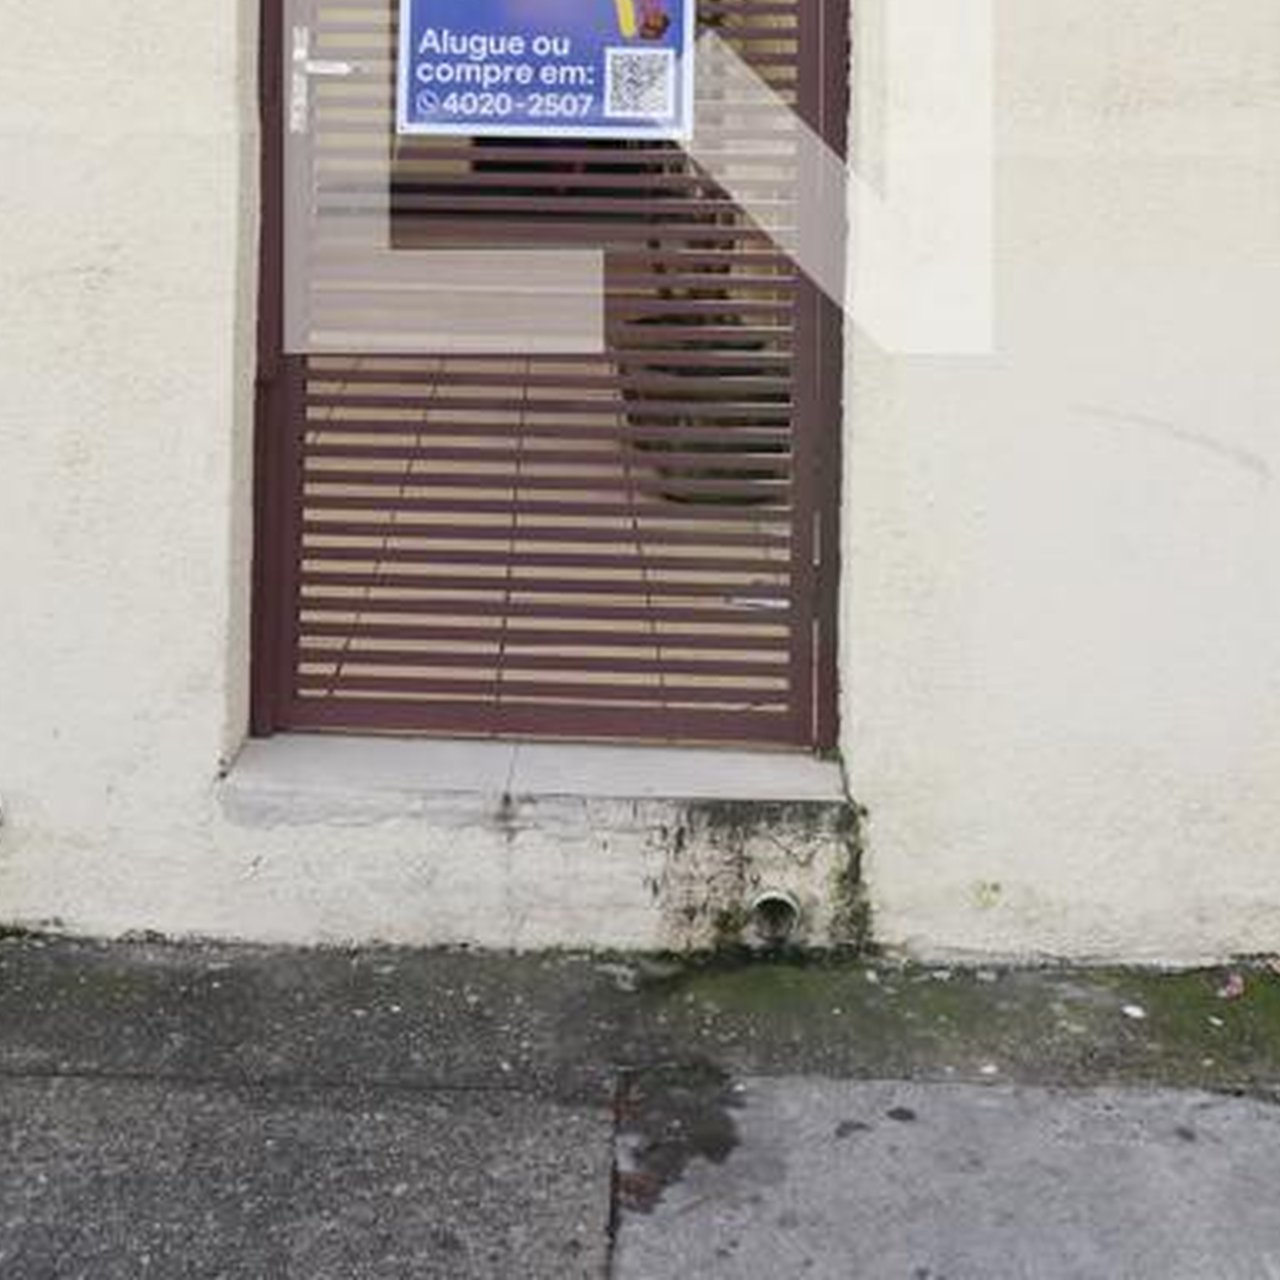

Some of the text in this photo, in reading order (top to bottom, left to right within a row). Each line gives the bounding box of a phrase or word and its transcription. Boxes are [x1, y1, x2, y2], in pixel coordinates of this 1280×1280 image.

[419, 28, 570, 61] Alugue ou
[416, 62, 595, 89] compre em:
[442, 92, 594, 117] 4020-2507
